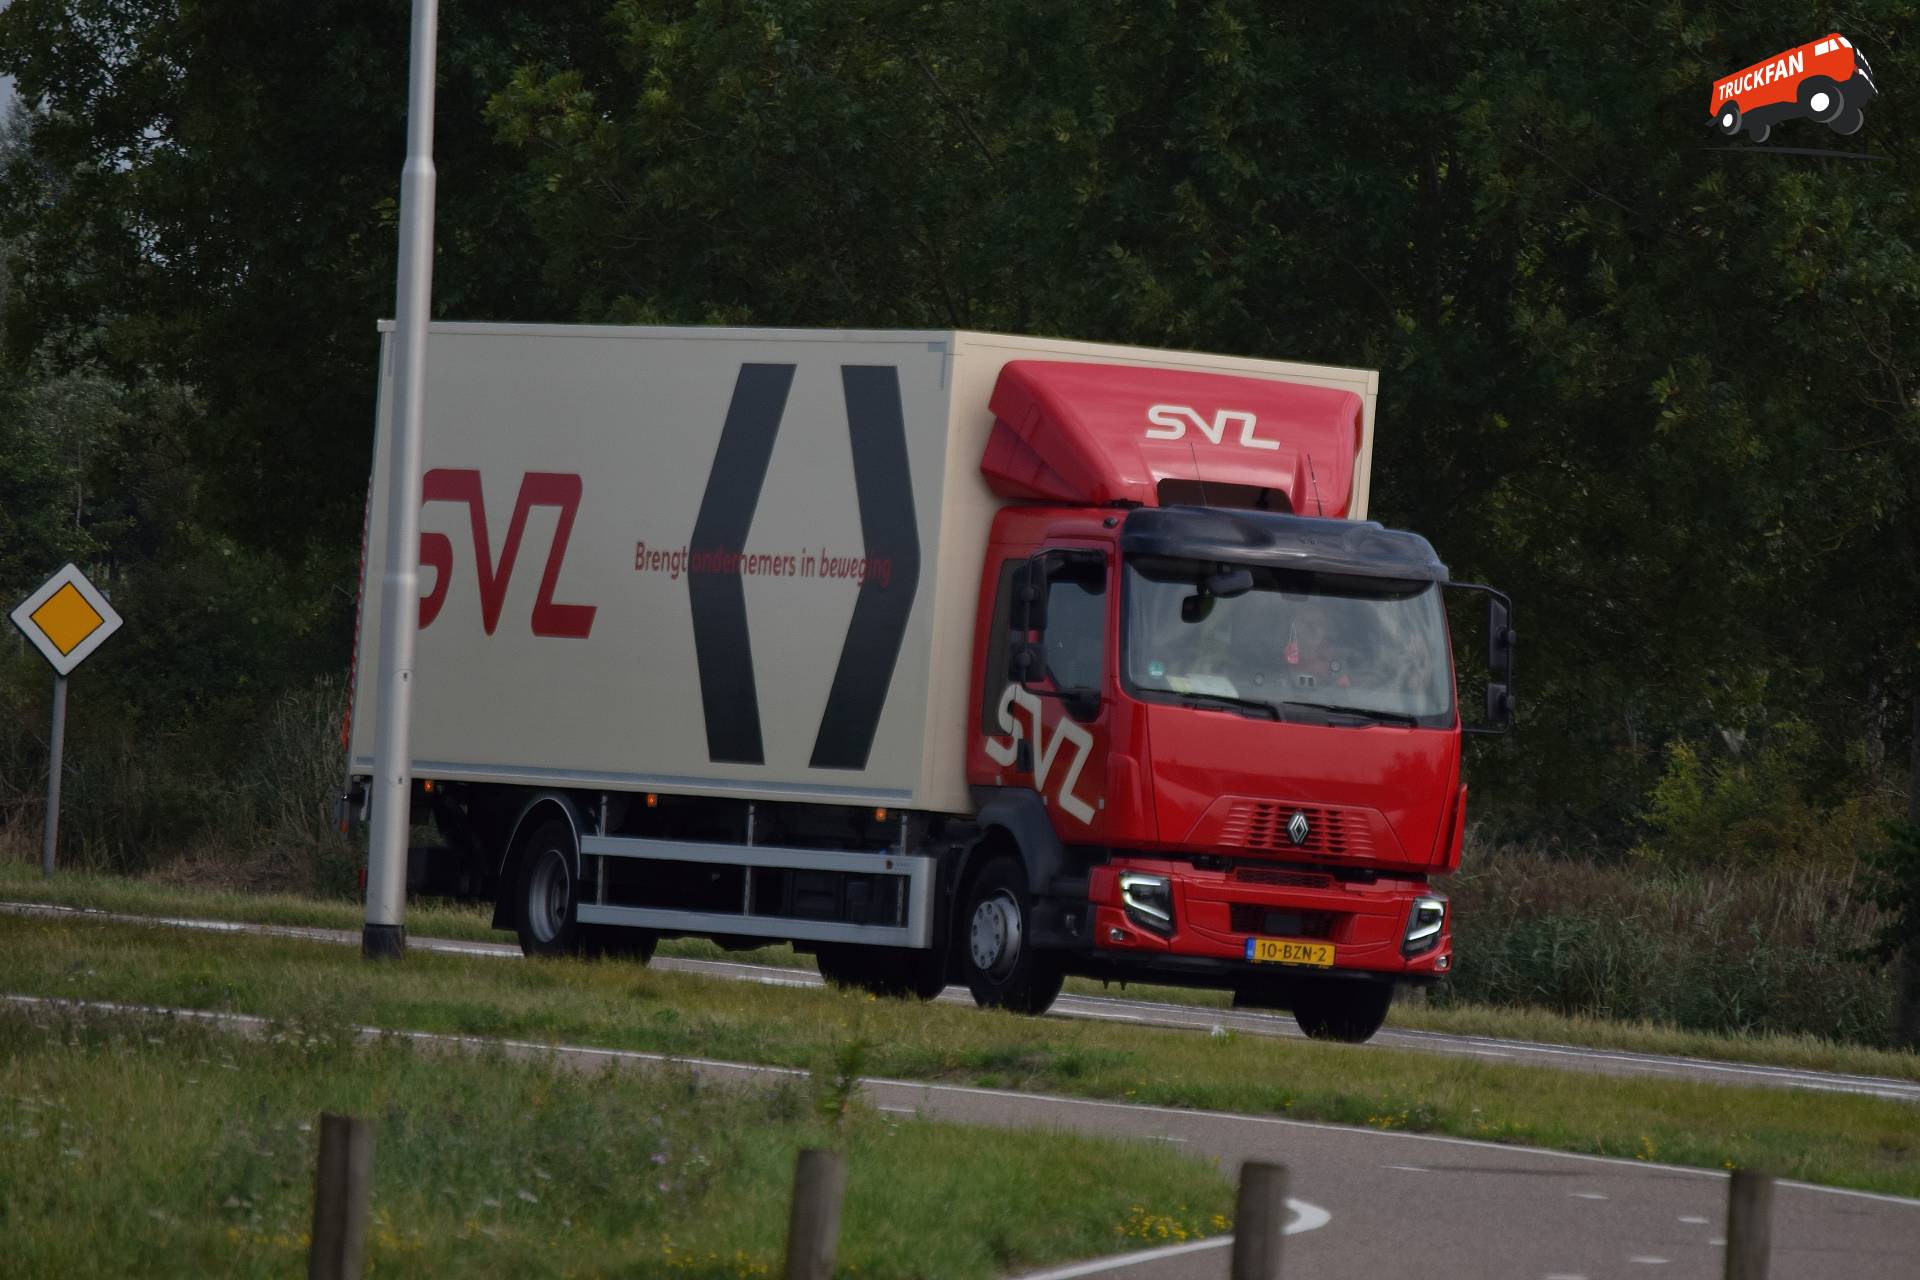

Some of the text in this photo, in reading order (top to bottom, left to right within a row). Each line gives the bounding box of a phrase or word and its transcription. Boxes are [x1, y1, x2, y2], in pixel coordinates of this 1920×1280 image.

[634, 541, 688, 580] Brengt
[692, 544, 797, 577] ondernemers
[801, 547, 816, 577] in
[1261, 943, 1327, 962] 10-BZN-2
